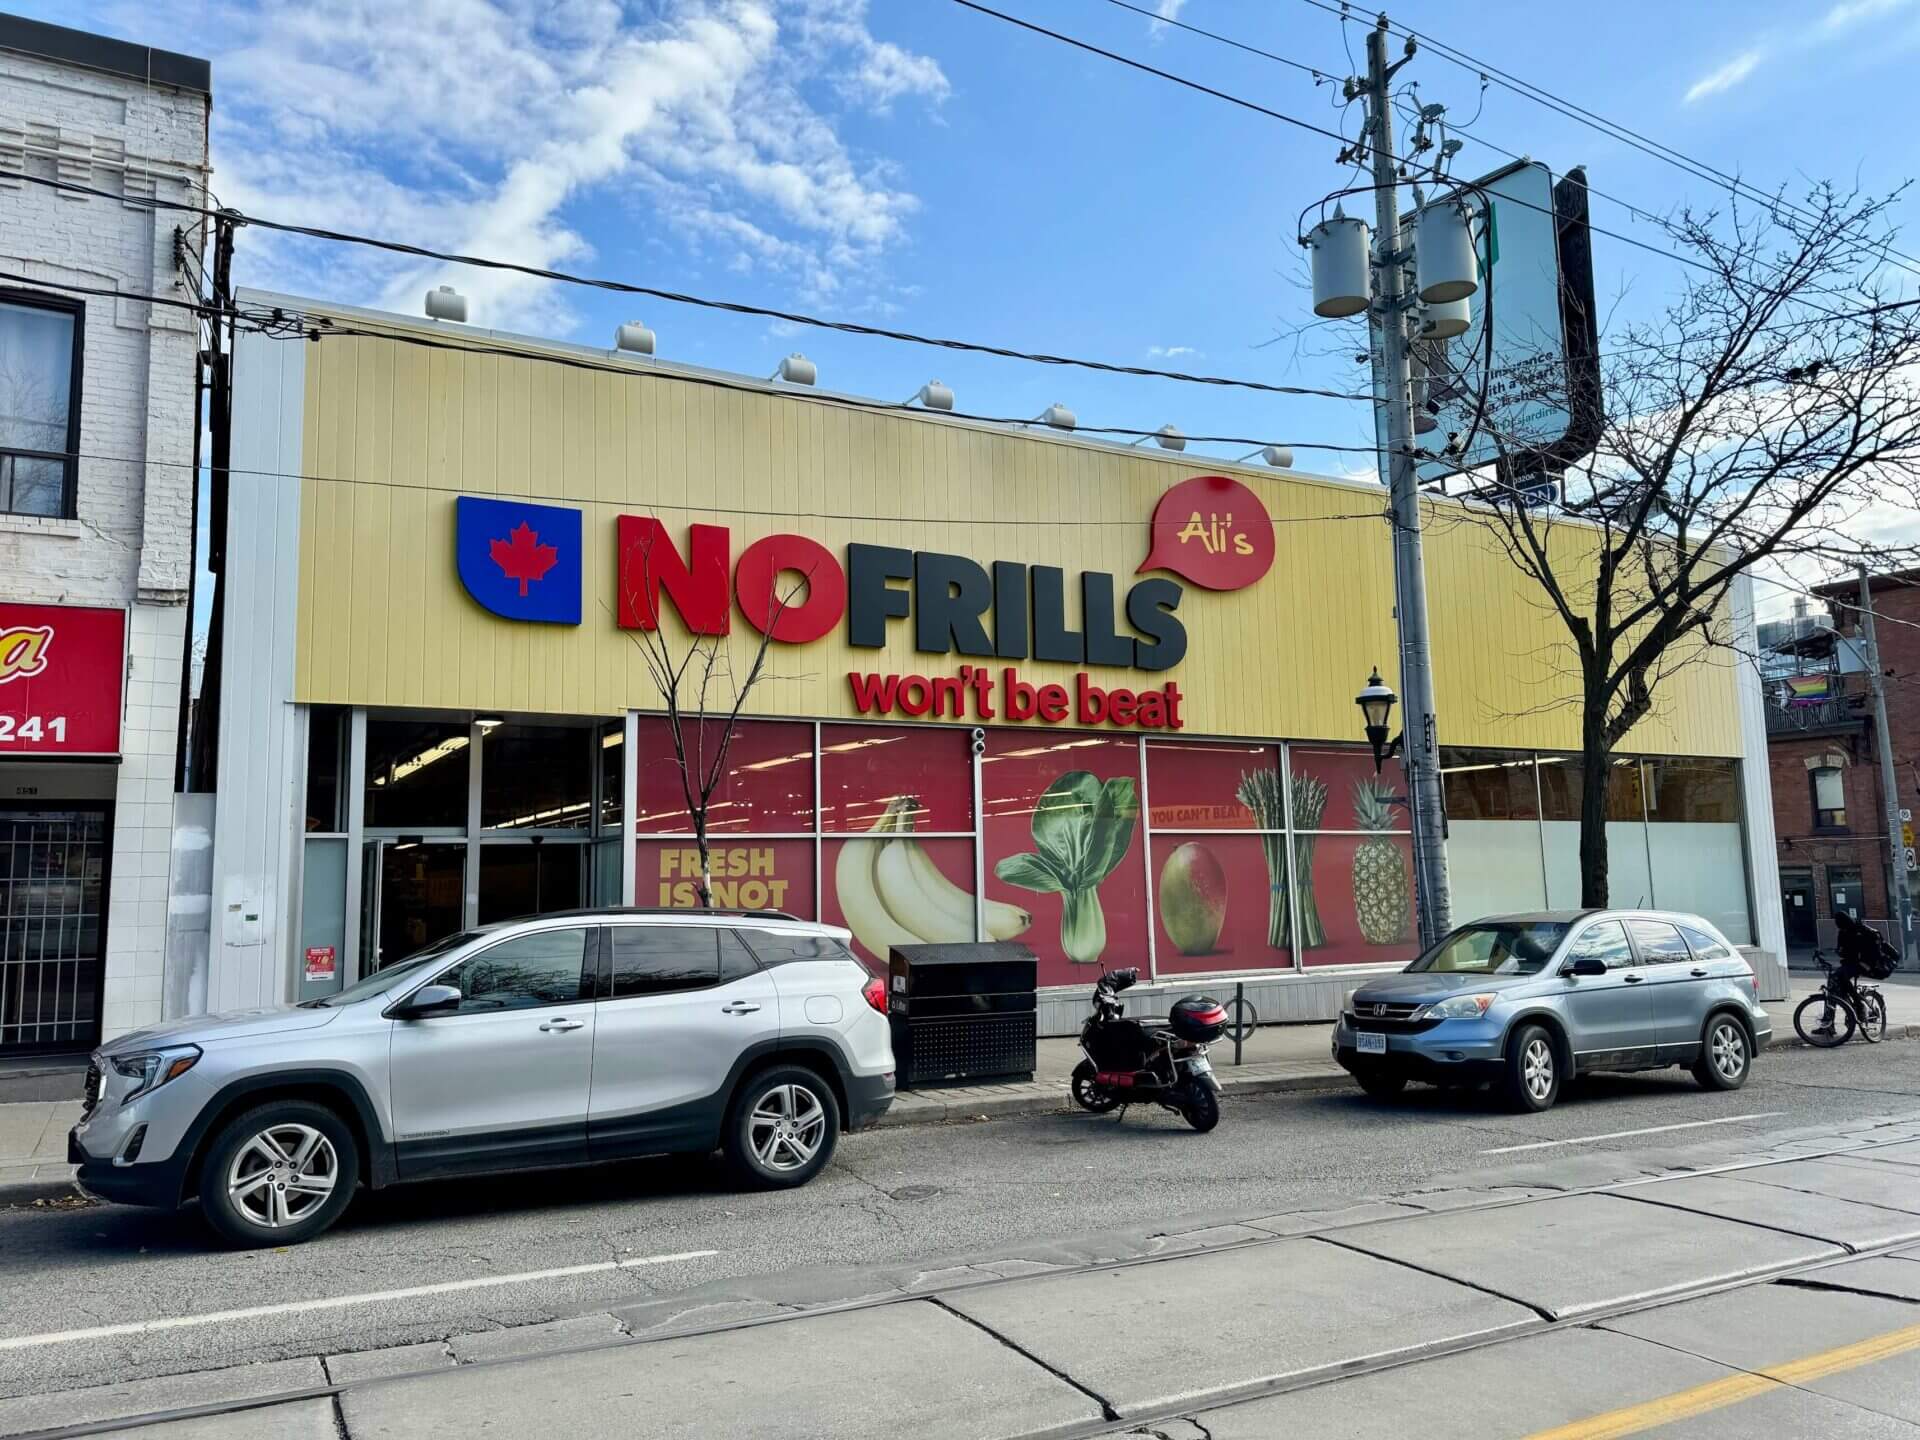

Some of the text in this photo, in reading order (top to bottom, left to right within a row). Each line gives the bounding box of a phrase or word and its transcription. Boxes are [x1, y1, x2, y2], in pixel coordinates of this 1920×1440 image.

[1176, 511, 1254, 555] Ali's
[847, 542, 1188, 671] FRILLS
[848, 665, 1184, 729] won't be beat
[1151, 806, 1241, 824] YOU CAN'T BEAT
[659, 848, 775, 878] FRESH
[659, 880, 789, 909] IS NOT
